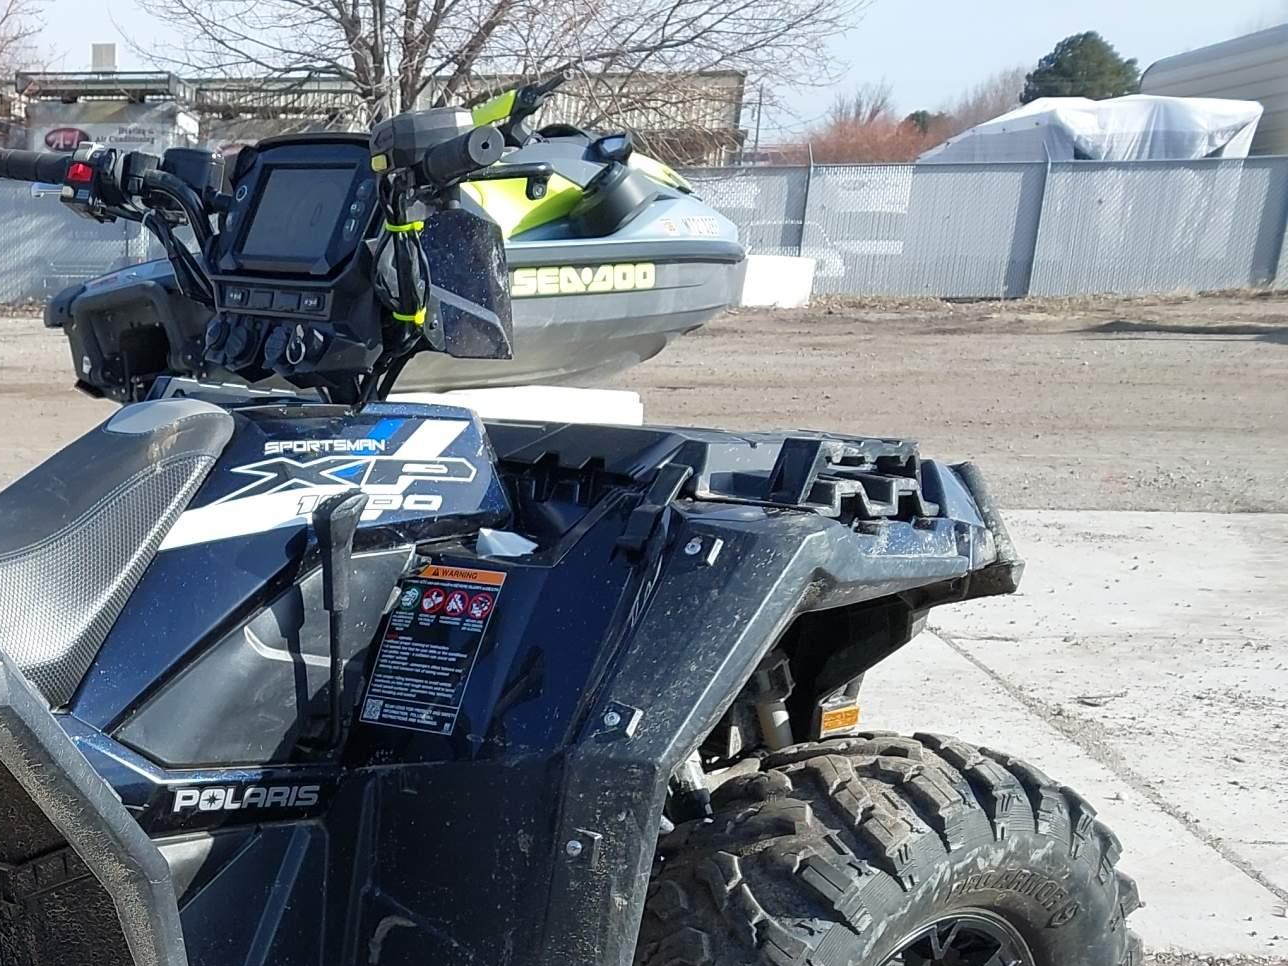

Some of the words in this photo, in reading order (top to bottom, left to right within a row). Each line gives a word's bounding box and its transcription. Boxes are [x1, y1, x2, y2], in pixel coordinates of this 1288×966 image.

[52, 131, 79, 149] A-1
[264, 439, 386, 456] SPORTSMAN
[215, 457, 477, 505] XP
[296, 494, 443, 516] 100
[442, 569, 478, 580] WARNING
[173, 786, 320, 812] POLARIS
